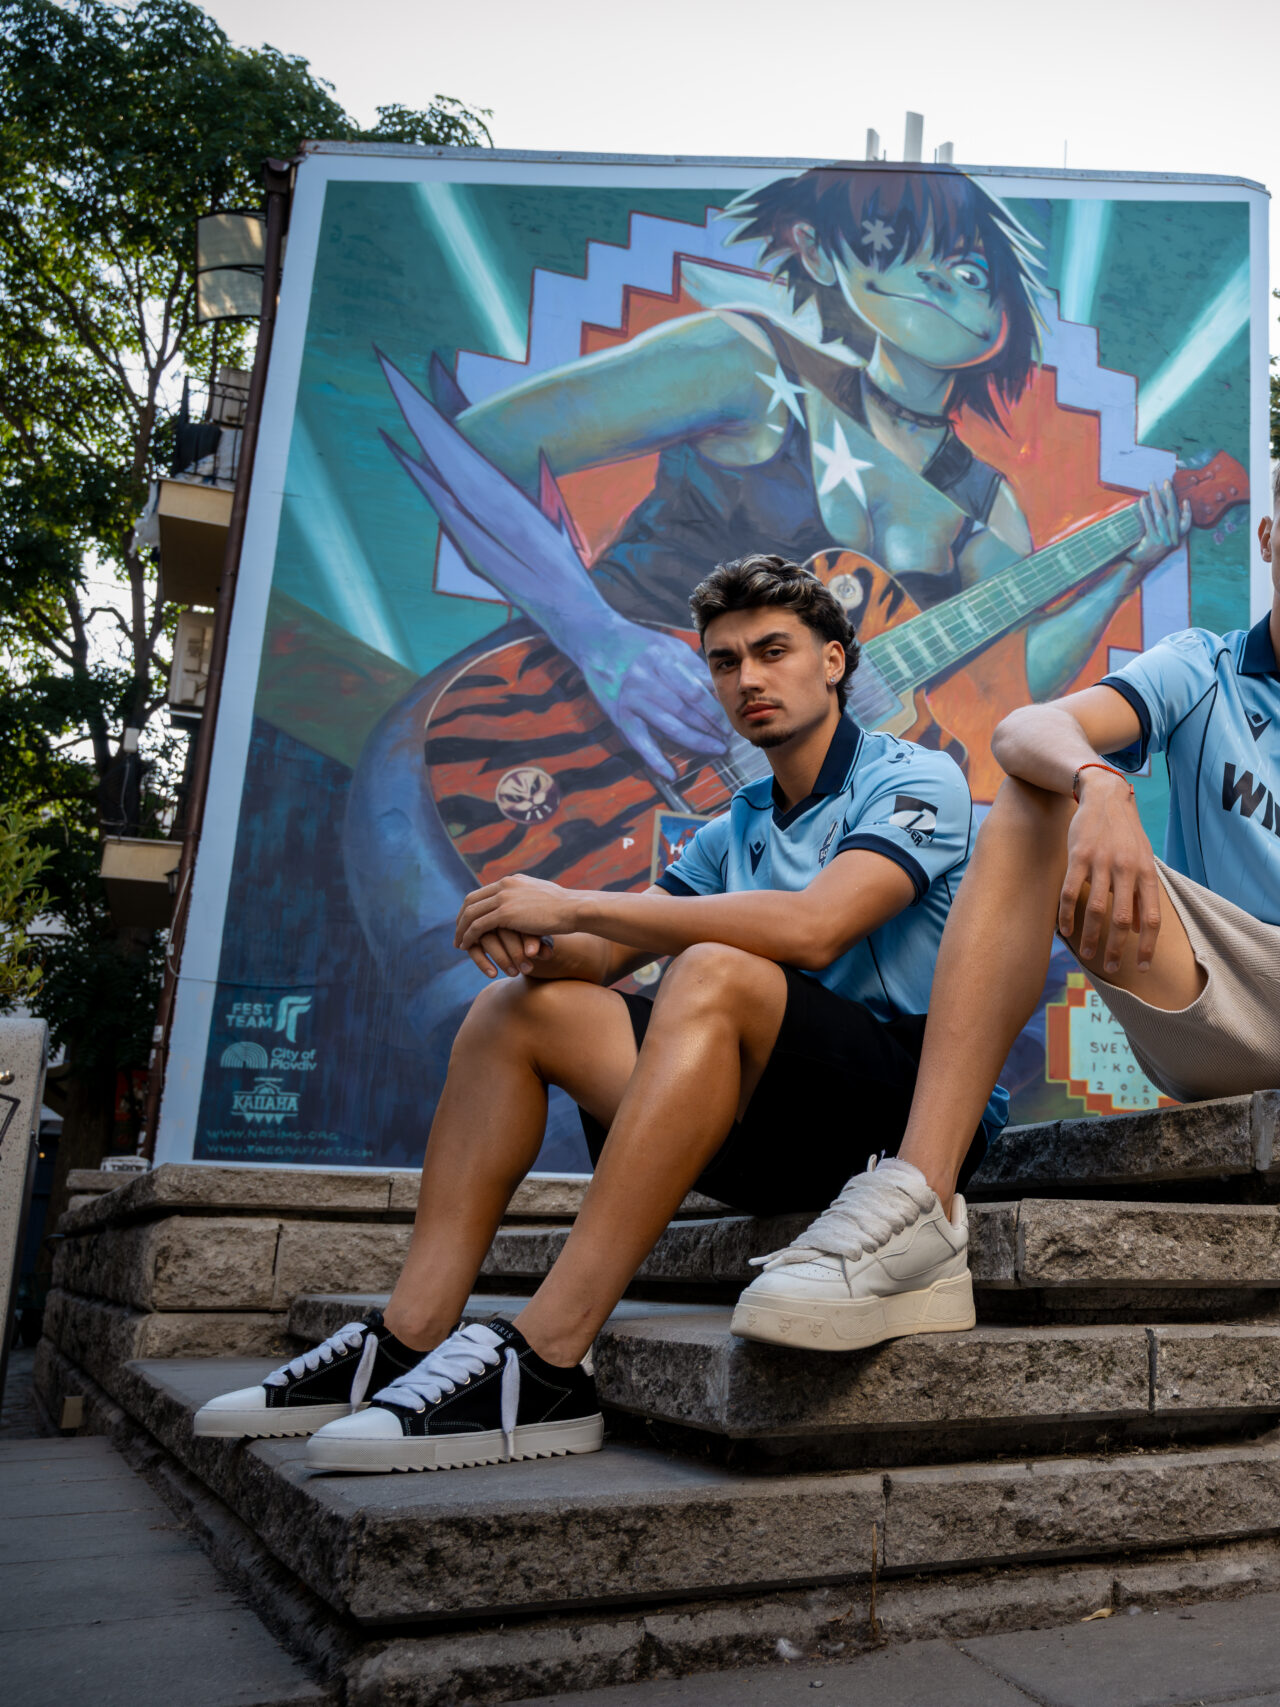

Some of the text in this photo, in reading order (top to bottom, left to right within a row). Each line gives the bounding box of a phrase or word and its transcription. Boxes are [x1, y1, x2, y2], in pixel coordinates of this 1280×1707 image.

[232, 1003, 273, 1016] FEST
[226, 1014, 273, 1028] TEAM
[271, 1047, 317, 1061] City of
[270, 1058, 317, 1071] Plovdiv
